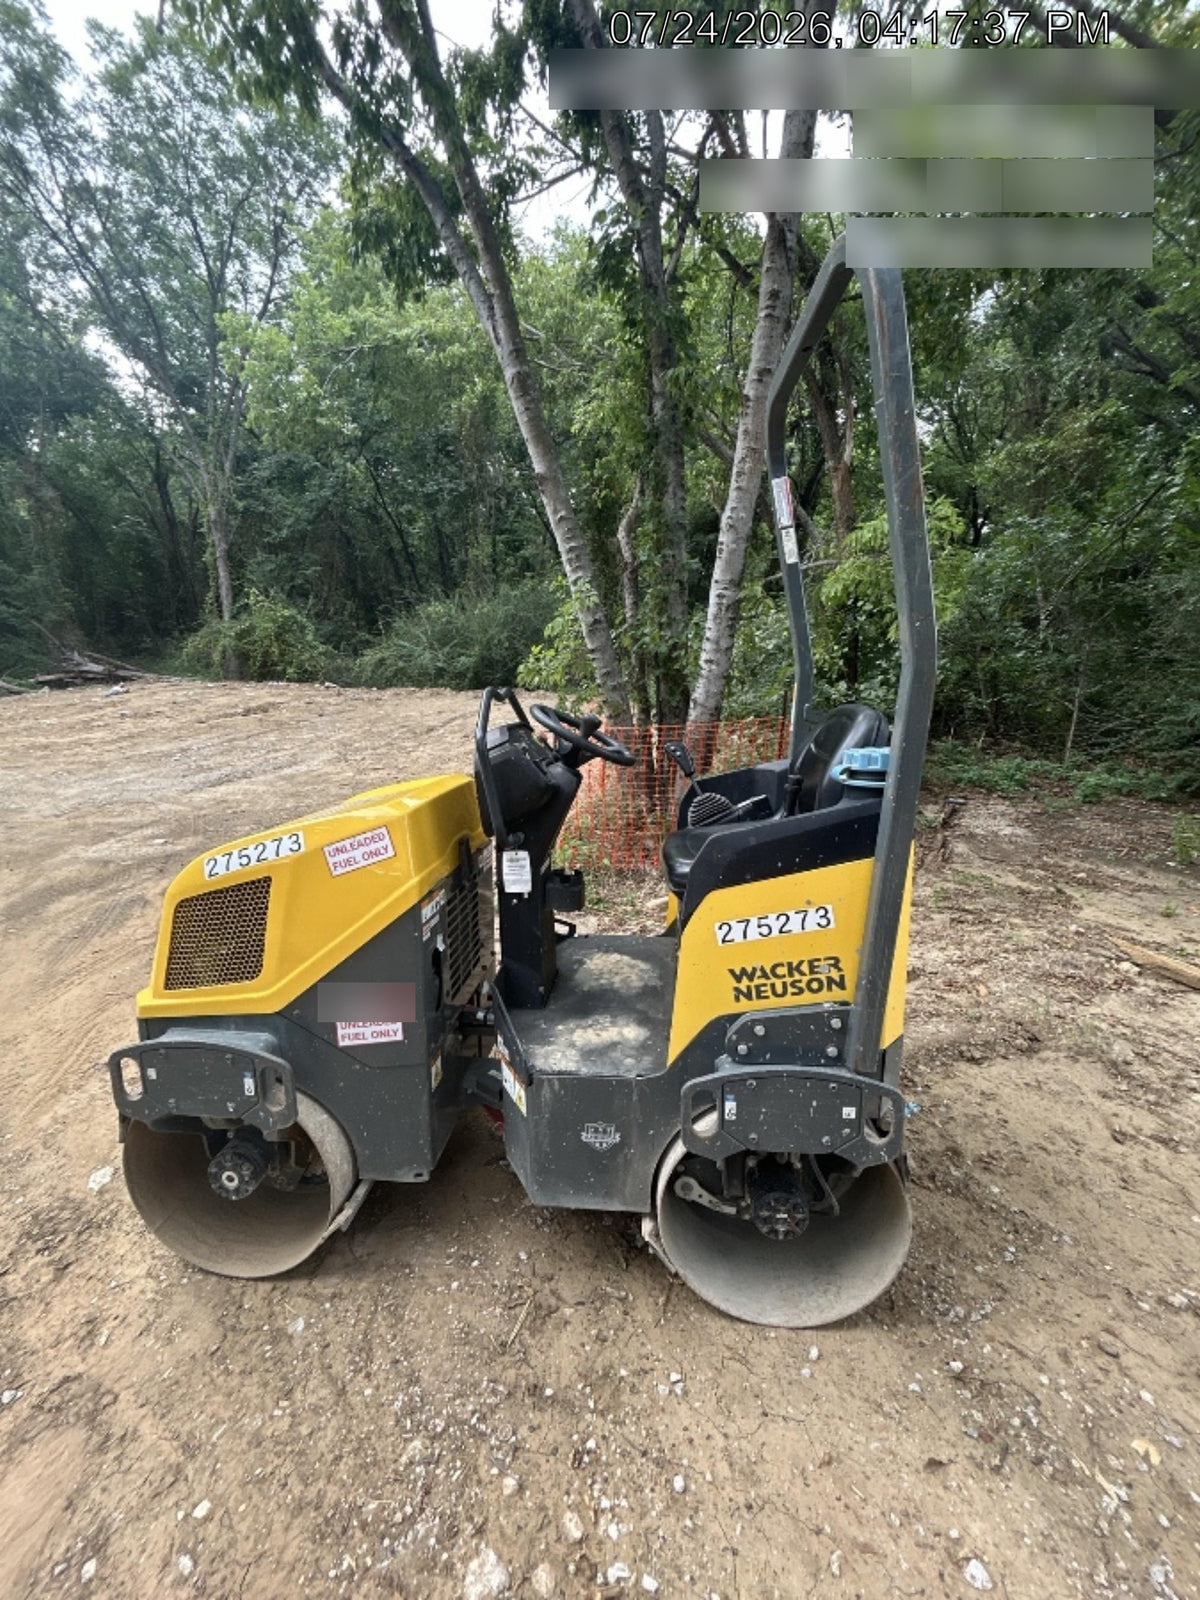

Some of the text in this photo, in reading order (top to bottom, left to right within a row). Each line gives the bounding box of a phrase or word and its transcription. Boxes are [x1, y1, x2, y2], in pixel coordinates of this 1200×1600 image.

[205, 833, 302, 878] 275273
[328, 831, 386, 857] UNLEADED
[332, 844, 389, 872] FUEL ONLY
[717, 906, 832, 945] 275273
[727, 956, 844, 984] WACKER
[732, 974, 847, 1003] NEUSON
[340, 1028, 399, 1042] FUEL ONLY
